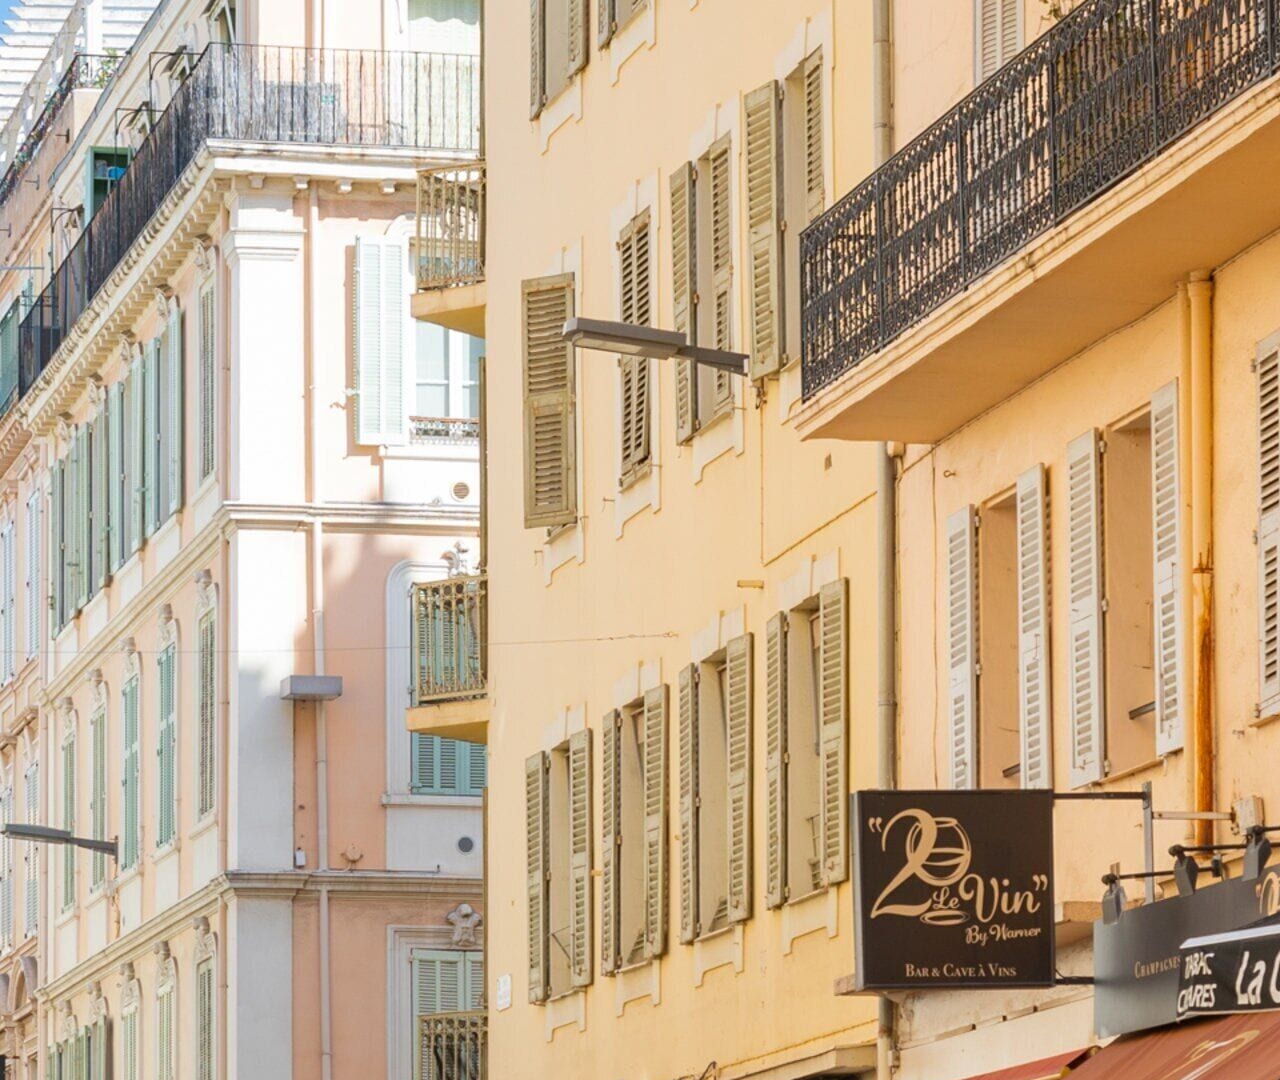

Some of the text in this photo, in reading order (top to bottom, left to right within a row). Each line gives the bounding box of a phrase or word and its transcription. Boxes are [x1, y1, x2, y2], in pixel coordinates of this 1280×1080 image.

[933, 887, 960, 910] Le
[965, 923, 1042, 947] By Warner
[931, 966, 940, 977] &
[1234, 950, 1262, 1006] La
